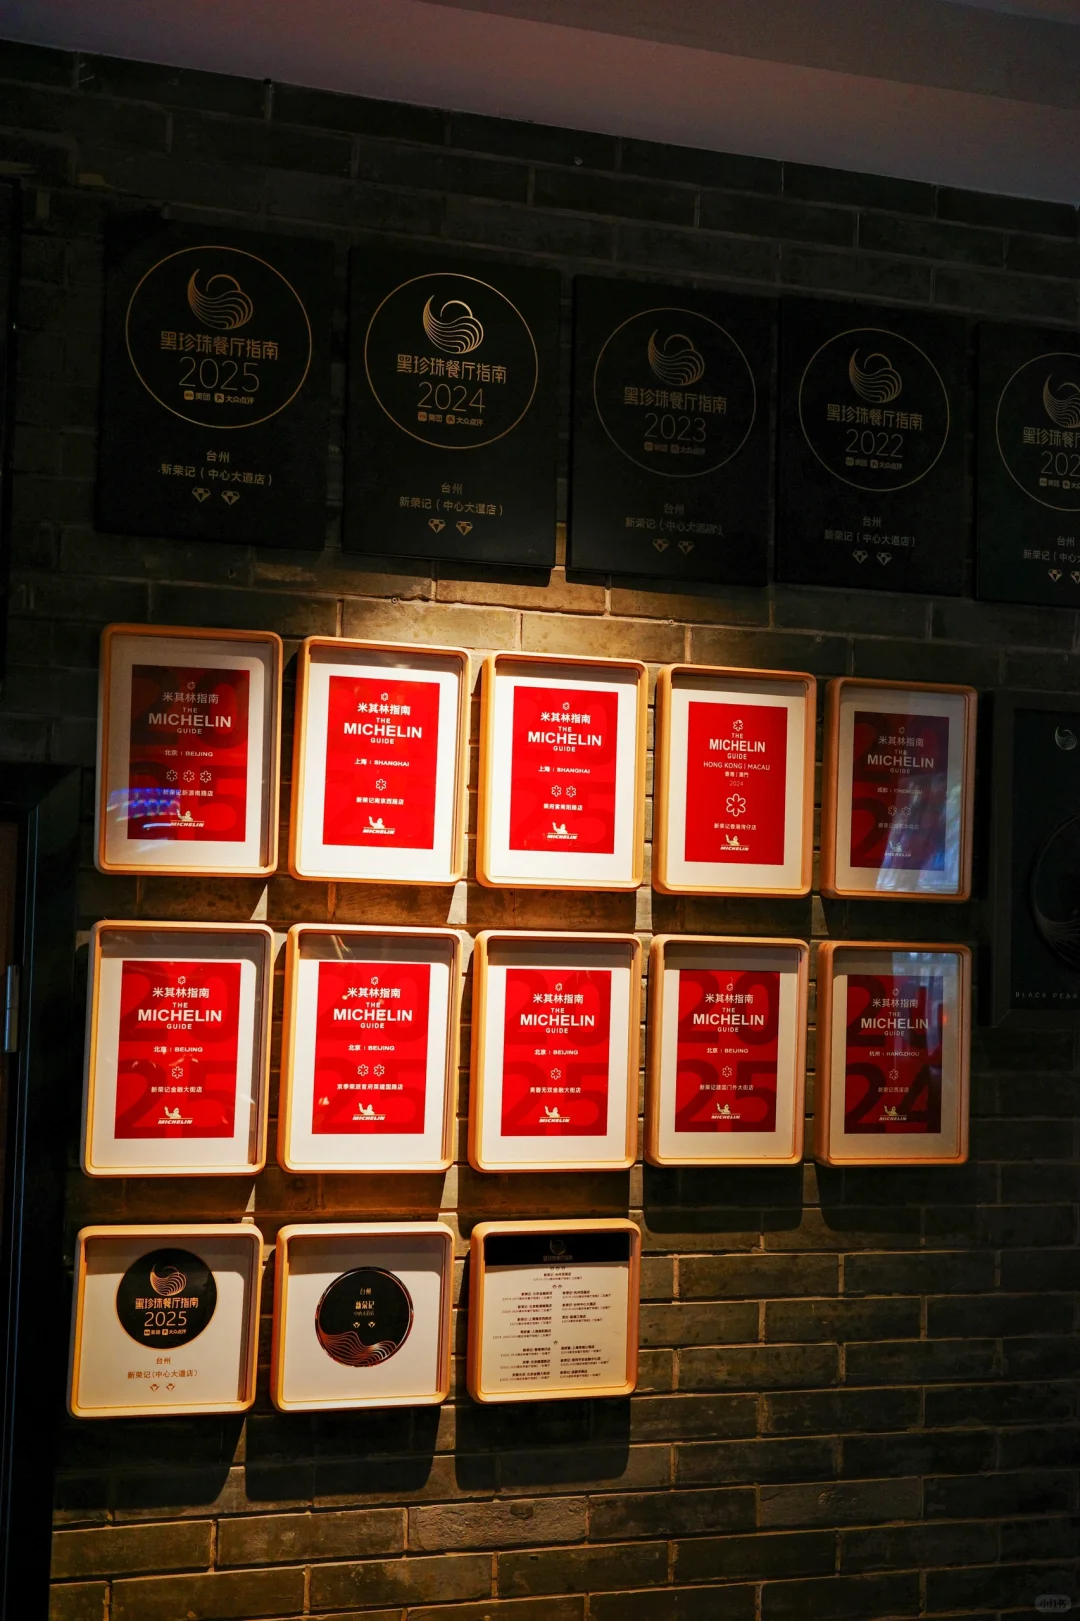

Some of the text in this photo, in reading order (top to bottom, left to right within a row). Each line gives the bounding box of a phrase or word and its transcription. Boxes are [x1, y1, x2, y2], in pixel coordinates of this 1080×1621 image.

[161, 331, 278, 361] 黑珍珠餐厅指南
[179, 356, 260, 393] 2025
[397, 353, 506, 385] 黑珍珠餐厅指南
[225, 395, 254, 404] 大众点评
[418, 382, 485, 414] 2024
[624, 387, 726, 415] 黑珍珠餐厅指南
[456, 417, 483, 426] 大众点评
[827, 404, 922, 431] 黑珍珠餐厅指南
[645, 413, 708, 443] 2023
[846, 429, 903, 458] 2022
[207, 450, 229, 462] 台州
[441, 483, 462, 494] 台州
[664, 503, 684, 514] 台州
[863, 516, 881, 527] 台州
[1057, 536, 1074, 546] 台州
[163, 692, 219, 704] 米其林指南
[358, 703, 410, 715] 米其林指南
[149, 712, 231, 729] MICHELIN
[541, 712, 590, 724] 米其林指南
[344, 722, 422, 739] MICHELIN
[528, 730, 601, 747] MICHELIN
[879, 736, 924, 747] 米其林指南
[710, 739, 765, 752] MICHELIN
[868, 754, 934, 769] MICHELIN
[153, 987, 209, 998] 米其林指南
[347, 987, 400, 998] 米其林指南
[706, 994, 753, 1003] 米其林指南
[533, 994, 583, 1004] 米其林指南
[873, 998, 918, 1008] 米其林指南
[138, 1009, 221, 1021] MICHELIN
[334, 1009, 412, 1021] MICHELIN
[521, 1014, 594, 1026] MICHELIN
[693, 1014, 763, 1025] MICHELIN
[861, 1017, 929, 1030] MICHELIN
[136, 1297, 198, 1309] 黑珍珠餐厅指南
[145, 1311, 186, 1326] 2025
